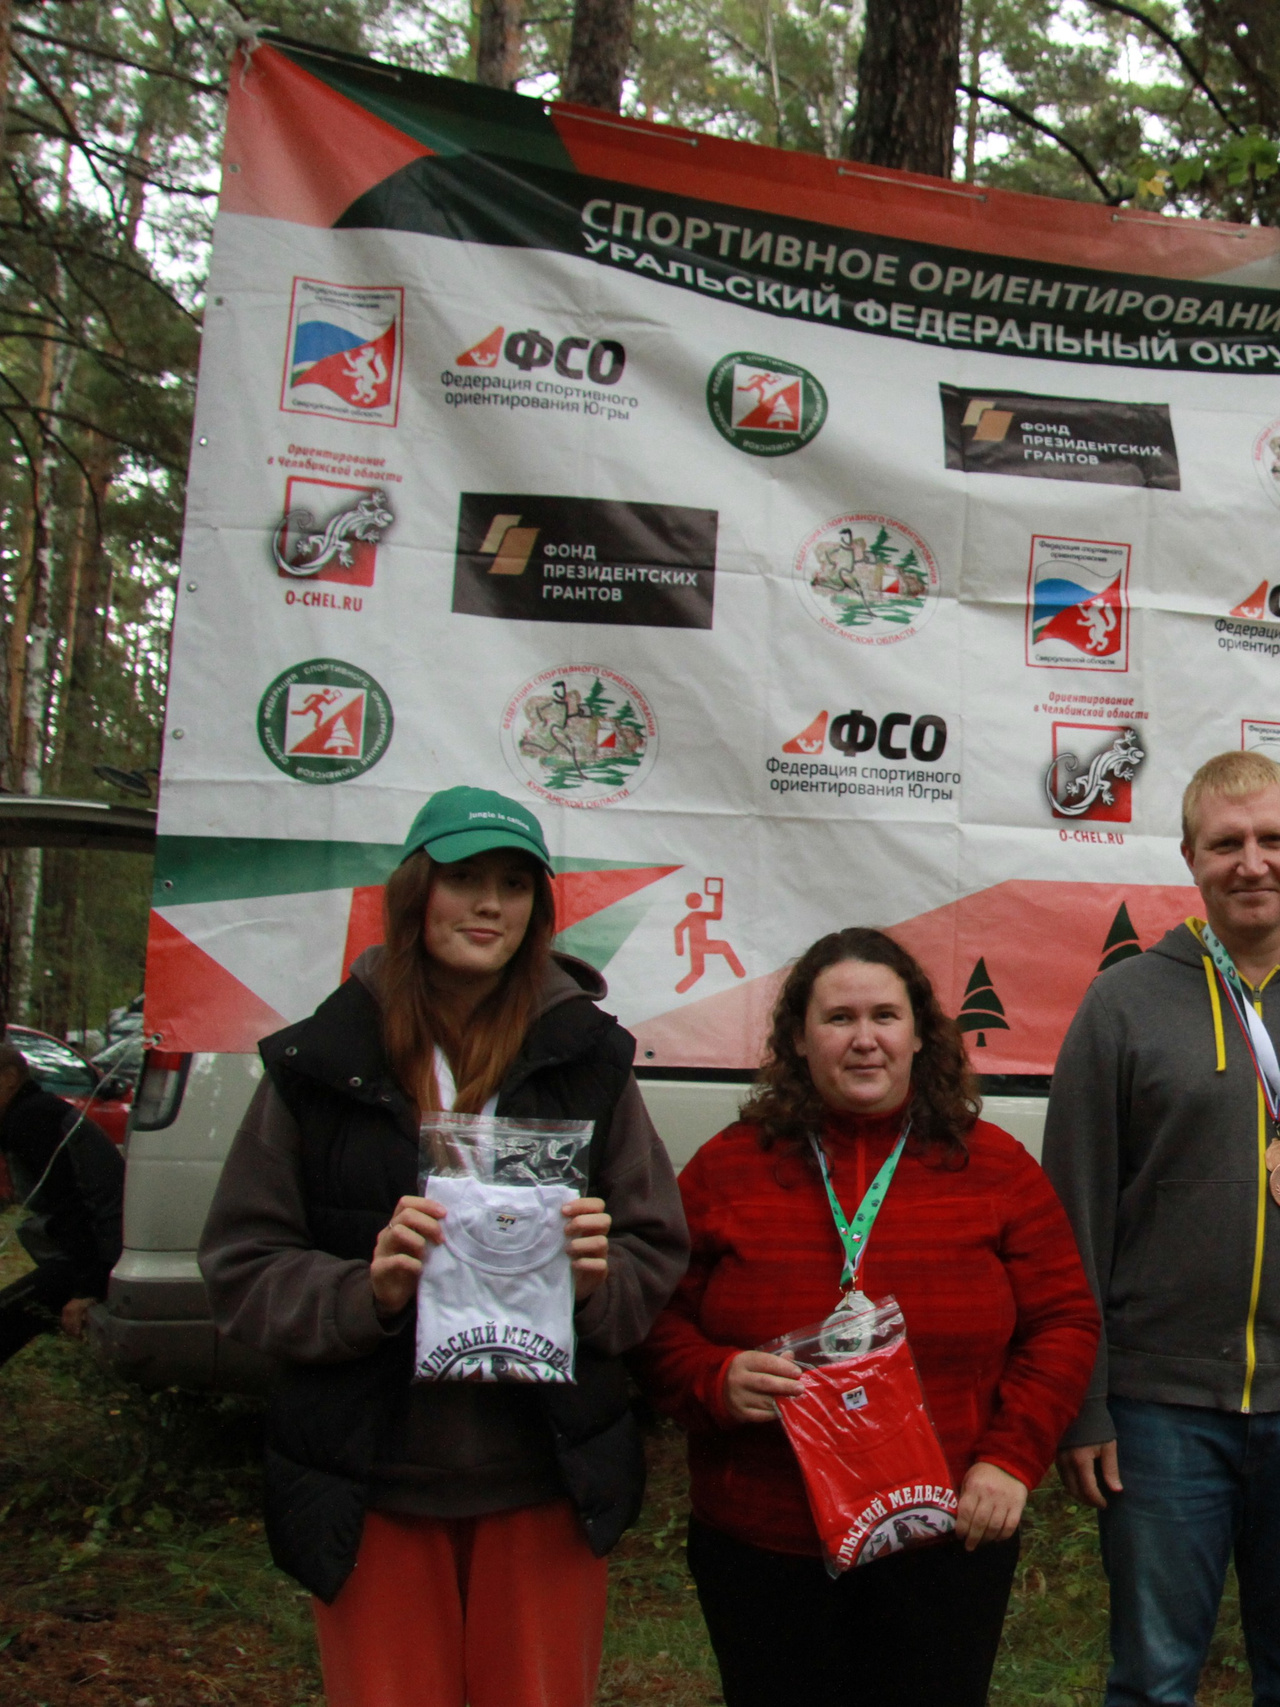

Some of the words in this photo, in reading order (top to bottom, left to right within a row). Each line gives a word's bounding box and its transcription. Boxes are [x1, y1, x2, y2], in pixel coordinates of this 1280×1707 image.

[581, 198, 900, 286] СПОРТИВНОЕ
[581, 231, 841, 320] УРАЛЬСКИЙ
[853, 299, 1179, 363] ФЕДЕРАЛЬНЫЙ
[503, 328, 626, 386] ФСО
[440, 370, 531, 391] Федерация
[535, 380, 639, 409] спортивного
[444, 390, 580, 412] ориентирования
[583, 401, 630, 420] Югры
[1020, 422, 1070, 436] ФОНД
[287, 443, 386, 468] Ориентирование
[1022, 434, 1162, 457] ПРЕЗИДЕНТСКИХ
[1023, 449, 1099, 465] ГРАНТОВ
[543, 543, 597, 561] ФОНД
[543, 564, 698, 587] ПРЕЗИДЕНТСКИХ
[285, 590, 363, 612] O-CHEL.RU
[542, 584, 623, 602] ГРАНТОВ
[503, 682, 533, 730] ФЕДЕРАЦИЯ
[533, 665, 600, 685] СПОРТИВНОГО
[601, 669, 656, 737] ОРИЕНТИРОВАНИЯ
[1033, 703, 1039, 712] в
[1042, 703, 1104, 719] Челябинской
[1107, 708, 1149, 720] области
[1048, 691, 1135, 707] Ориентирование
[829, 709, 947, 762] ФСО
[766, 757, 857, 778] Федерация
[861, 765, 961, 784] спортивного
[526, 780, 584, 809] КУРГАНСКОЙ
[587, 788, 630, 809] ОБЛАСТИ
[770, 778, 903, 798] ориентирования
[908, 783, 953, 803] Югры
[1059, 829, 1125, 845] O-CHEL.RU
